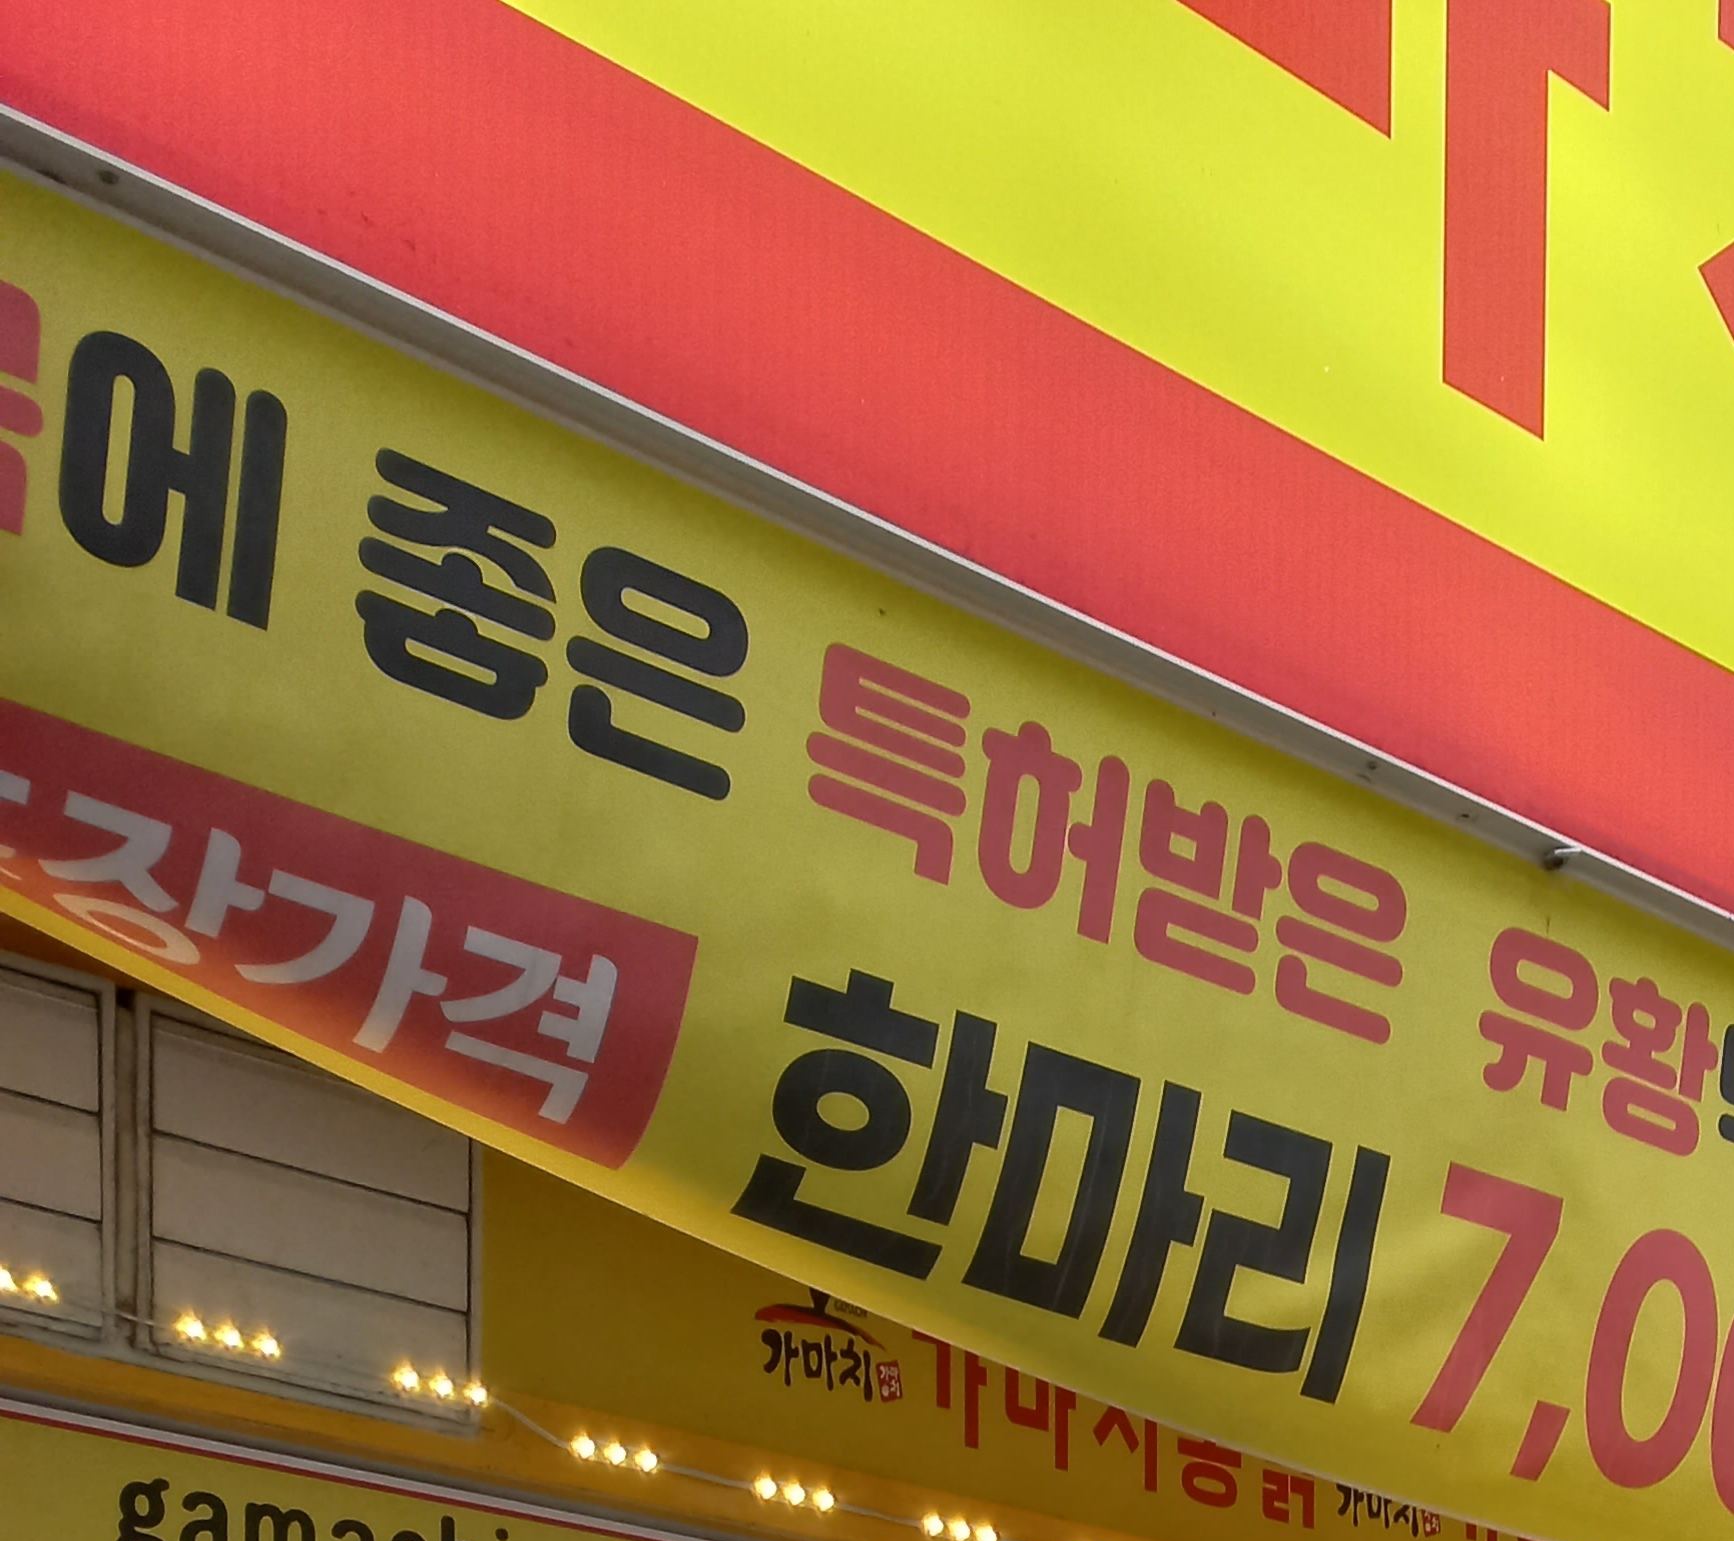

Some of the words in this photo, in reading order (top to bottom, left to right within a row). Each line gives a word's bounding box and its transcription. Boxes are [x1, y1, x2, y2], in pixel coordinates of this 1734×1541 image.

[355, 446, 750, 802] 좋은
[806, 642, 1407, 1046] 특허받은
[730, 968, 1392, 1404] 한마리
[761, 1328, 873, 1402] 가마치
